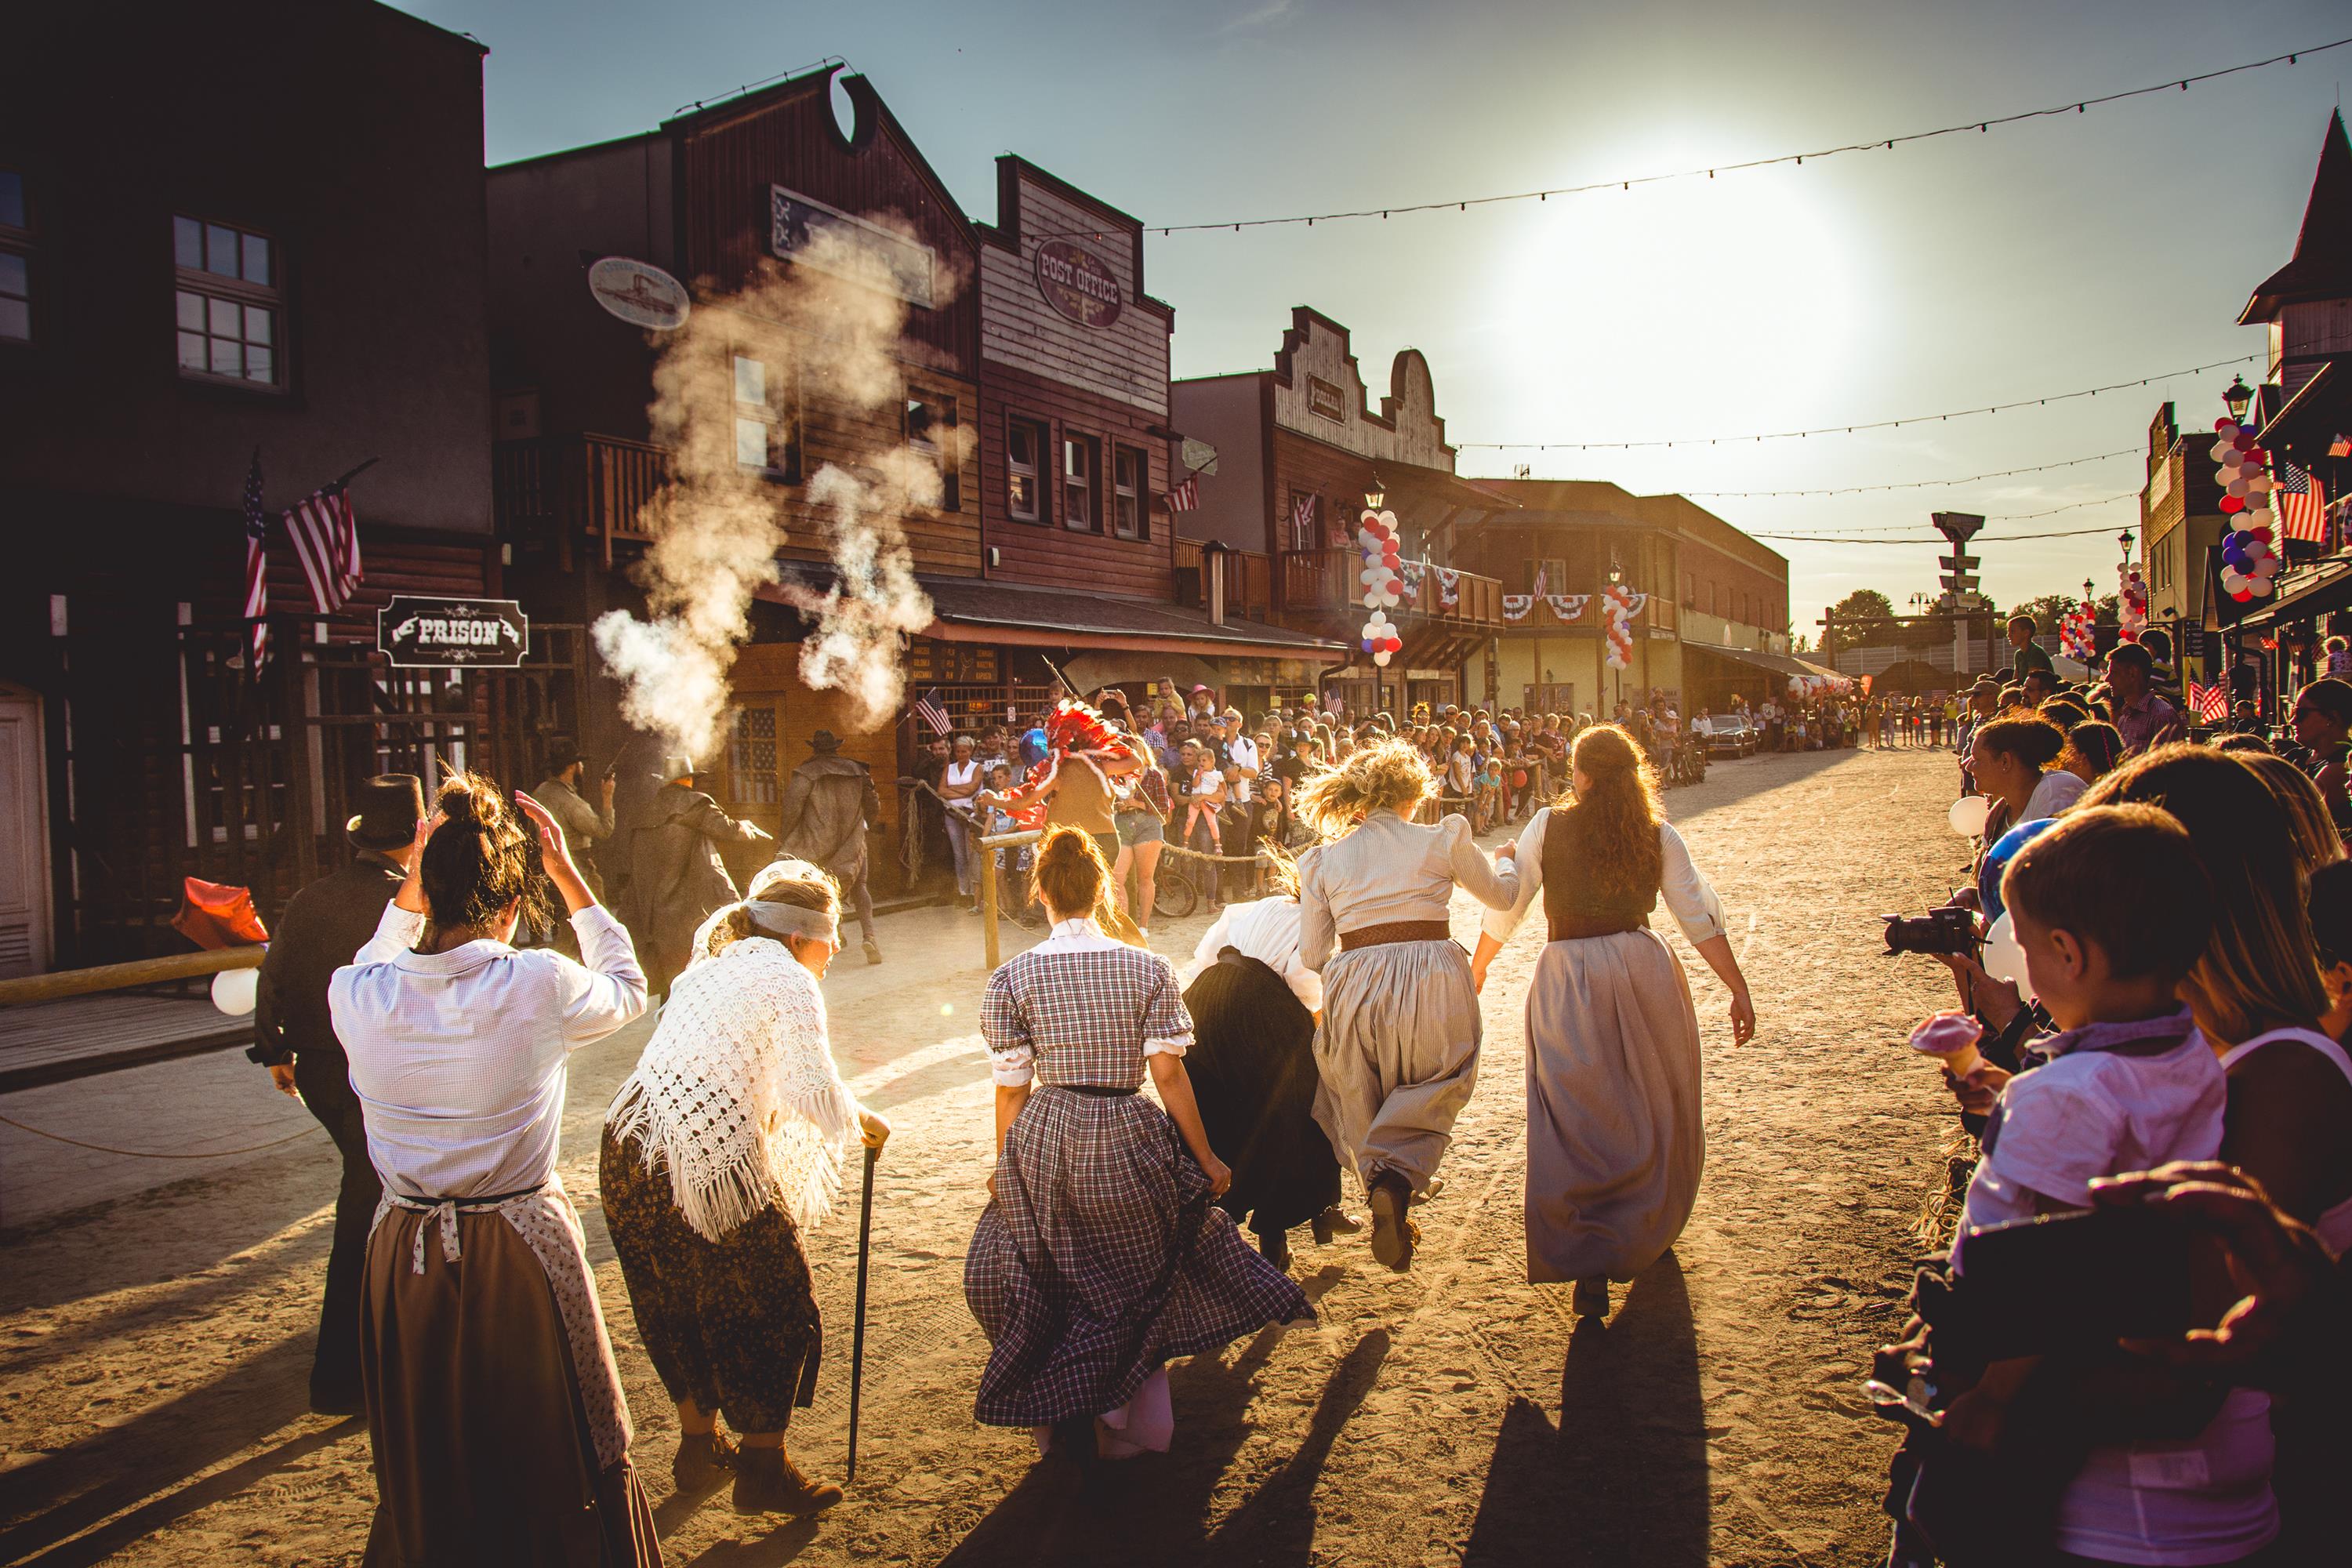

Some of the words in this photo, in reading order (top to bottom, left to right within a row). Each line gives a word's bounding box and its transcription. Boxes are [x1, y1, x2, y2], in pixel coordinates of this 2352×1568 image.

[1041, 253, 1073, 286] POST
[1076, 268, 1117, 304] OFFICE
[418, 618, 499, 646] PRISON
